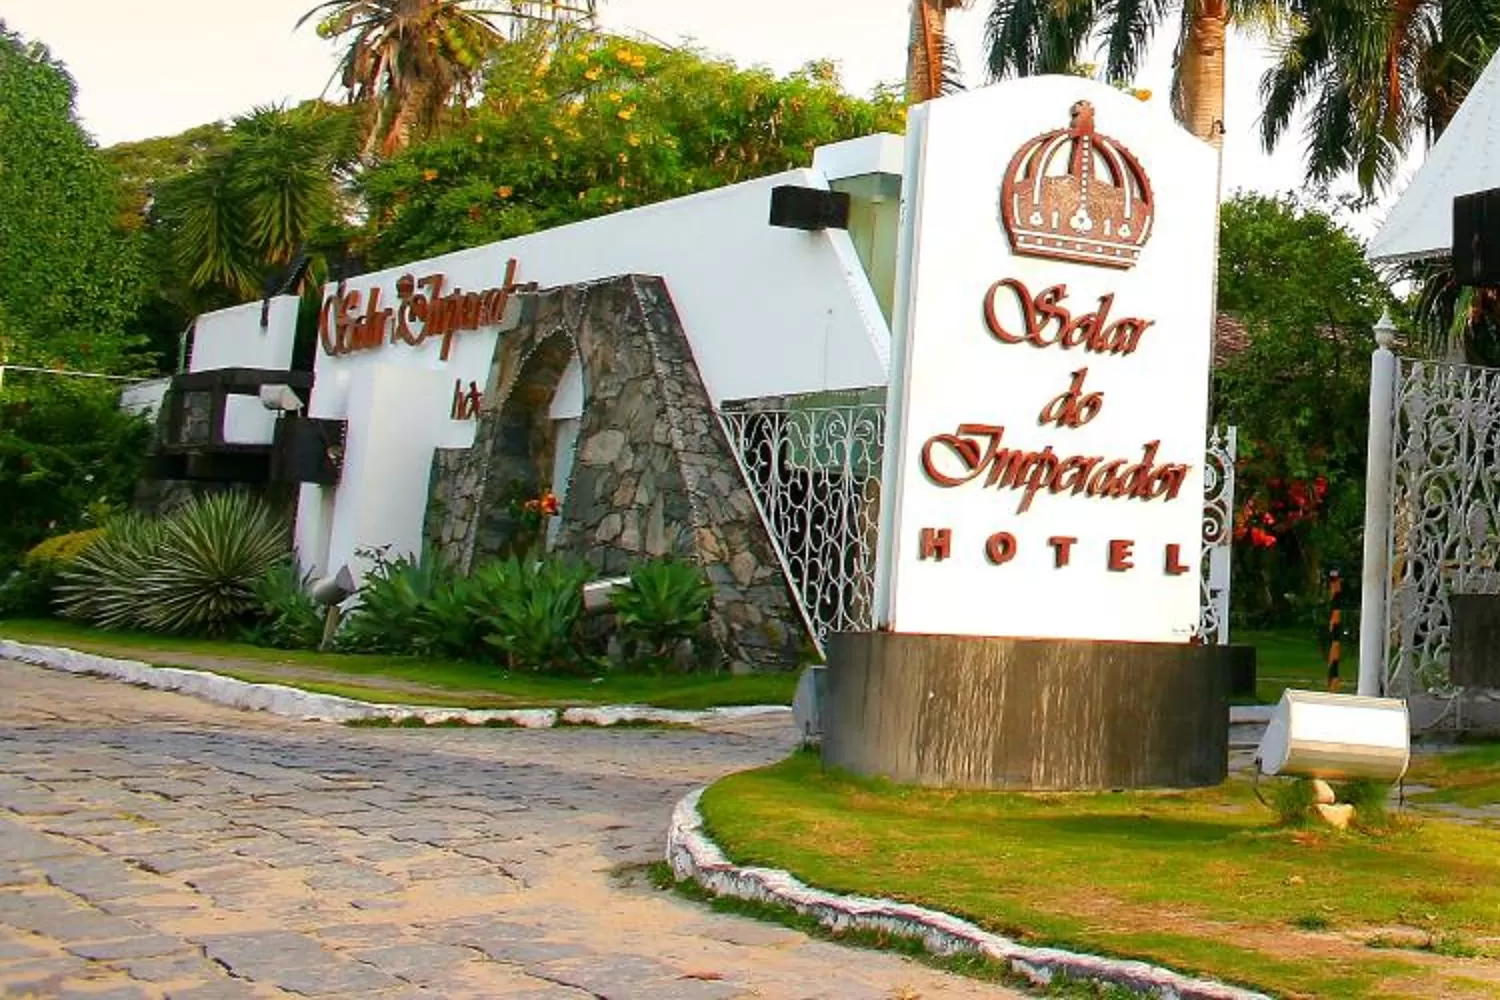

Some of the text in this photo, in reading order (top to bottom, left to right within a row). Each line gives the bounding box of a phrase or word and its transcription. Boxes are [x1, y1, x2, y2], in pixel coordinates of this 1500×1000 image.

[982, 278, 1155, 357] Solar
[1037, 367, 1104, 428] do
[919, 423, 1194, 516] Imperador
[918, 527, 1191, 576] HOTEL
